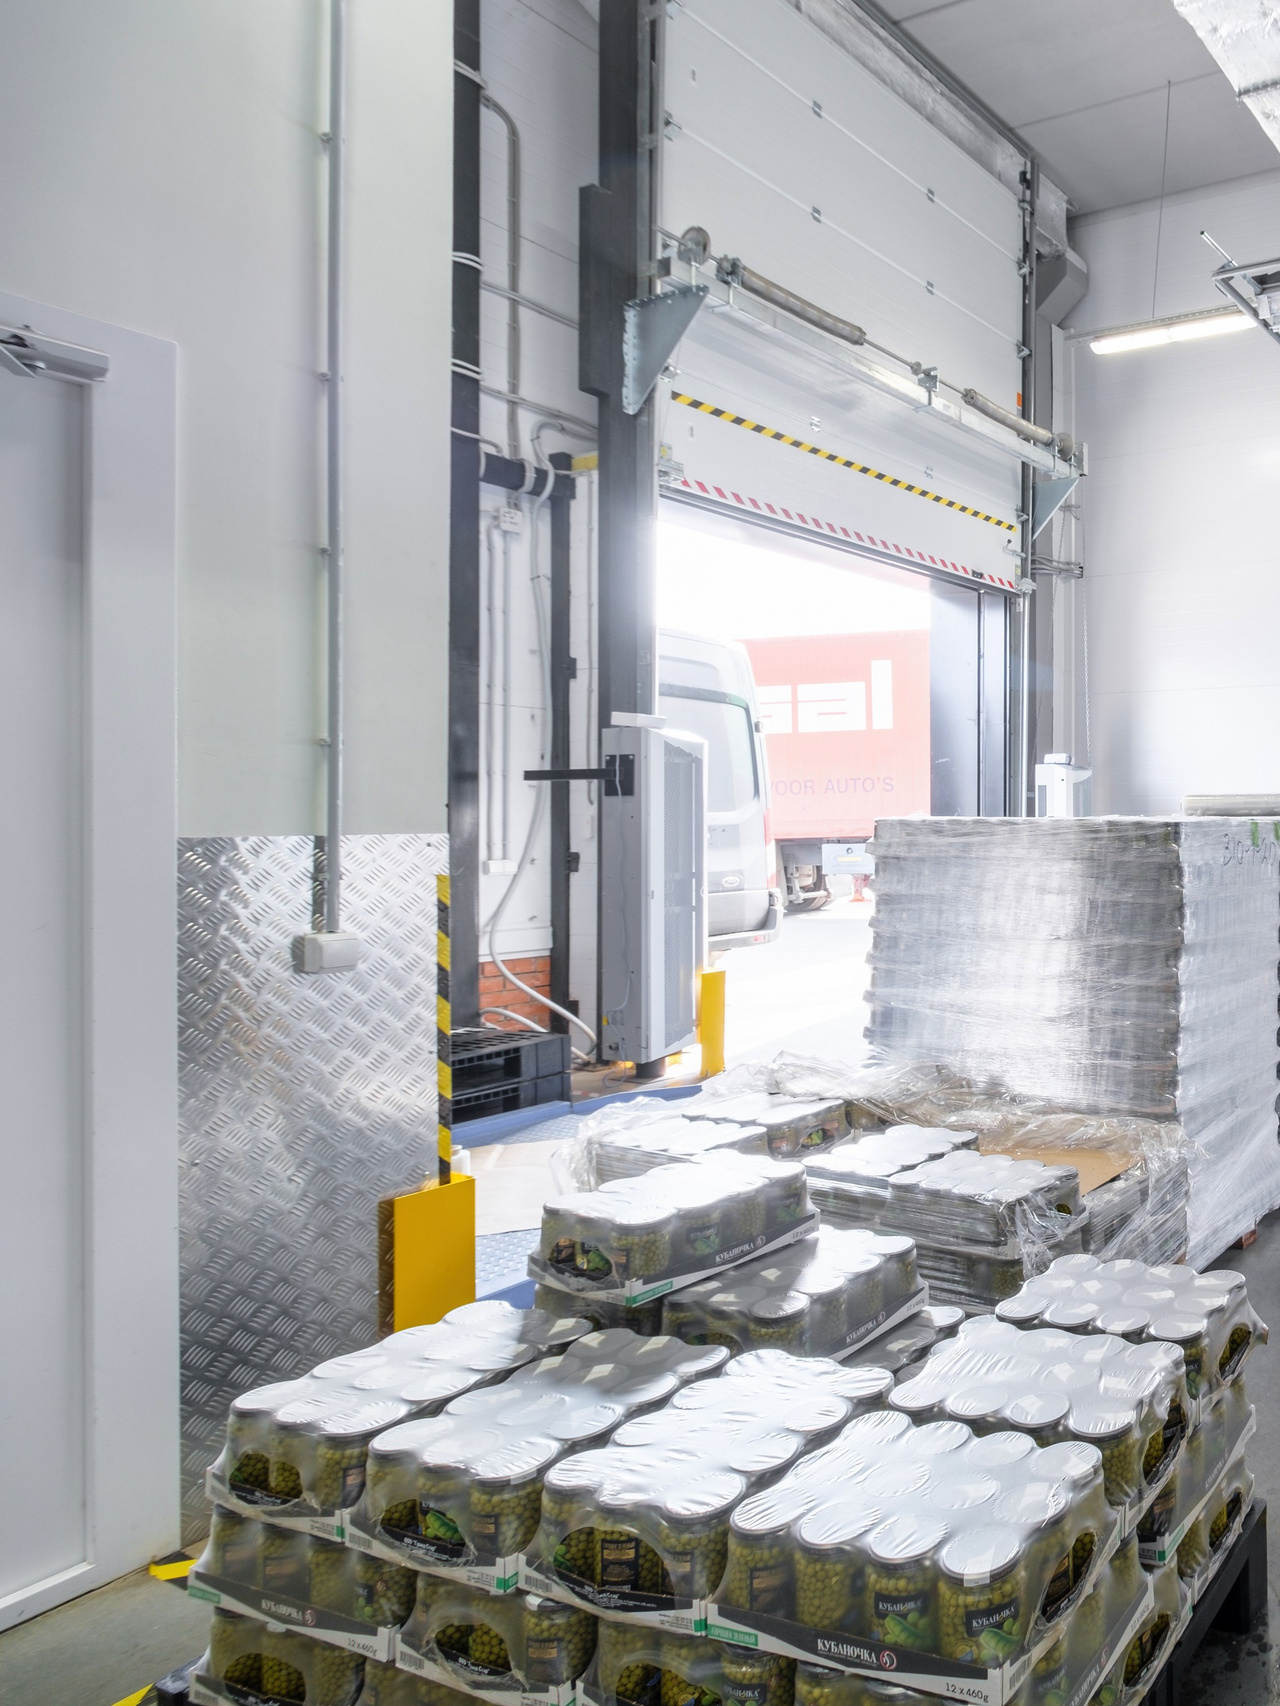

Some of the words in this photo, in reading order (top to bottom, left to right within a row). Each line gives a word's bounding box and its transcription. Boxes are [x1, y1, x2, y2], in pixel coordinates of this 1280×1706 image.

[824, 776, 894, 795] AUTO'S
[817, 1638, 877, 1663] КУБАНОЧКА
[946, 1682, 957, 1694] 12
